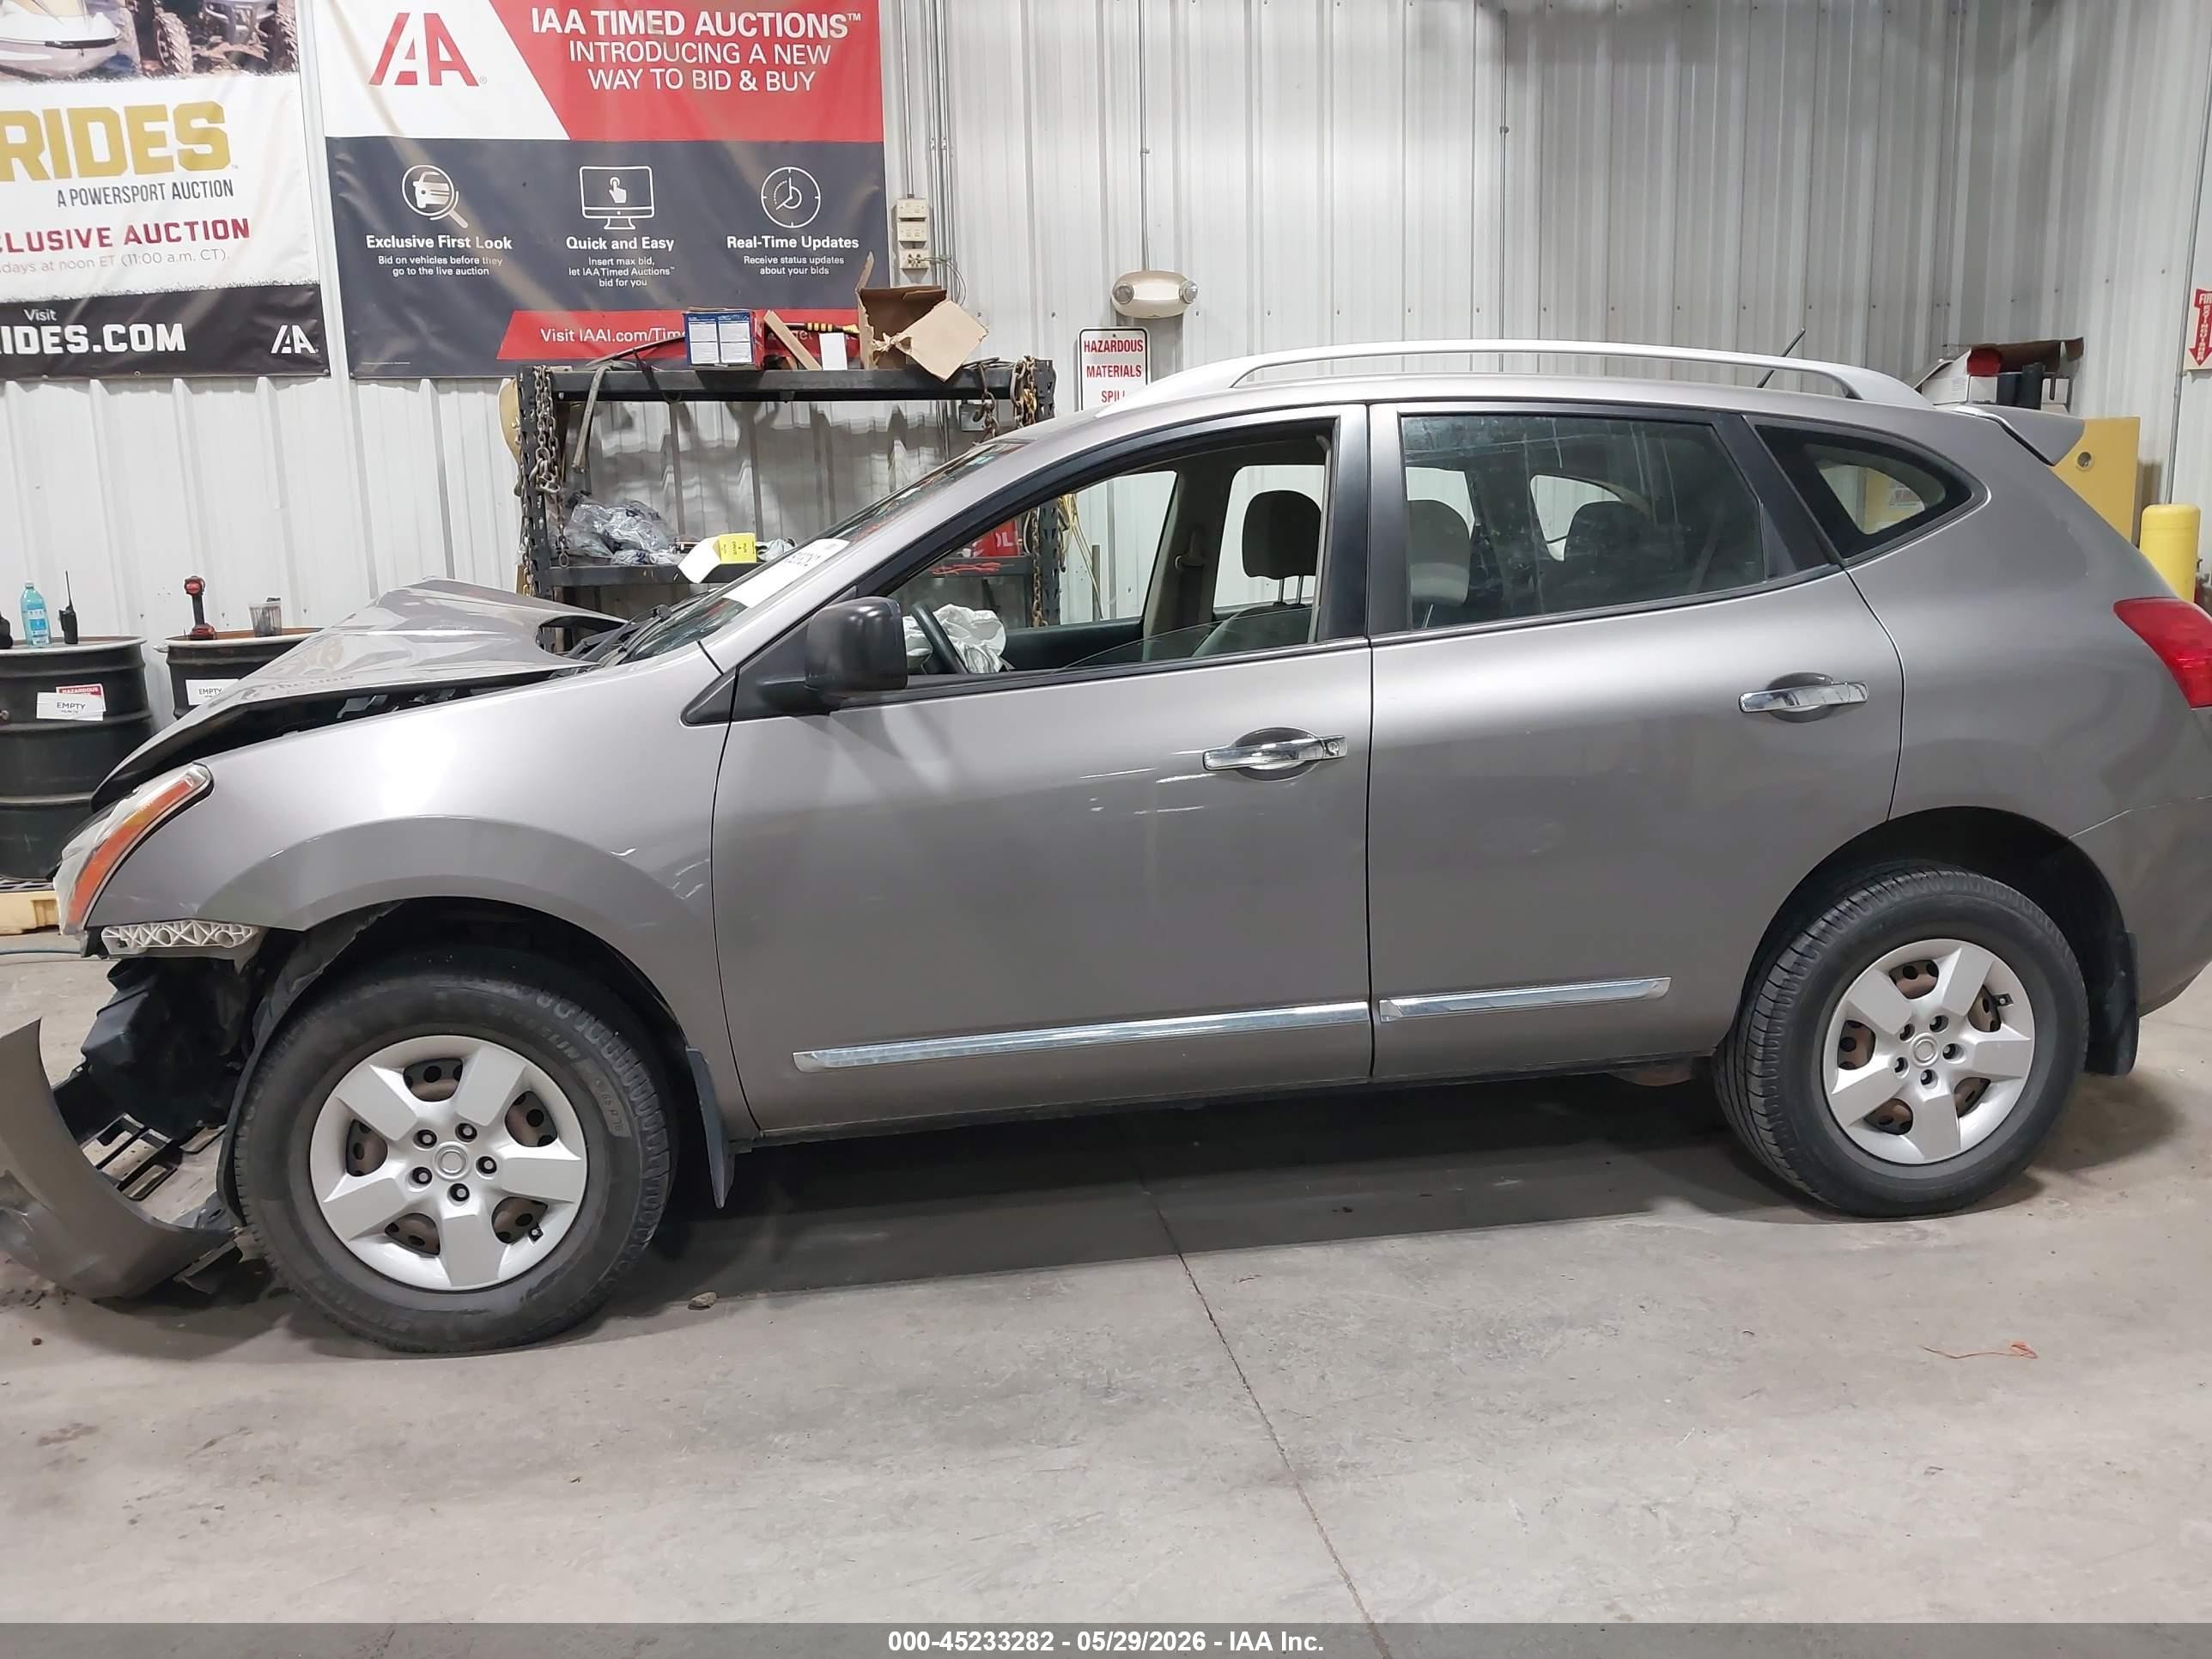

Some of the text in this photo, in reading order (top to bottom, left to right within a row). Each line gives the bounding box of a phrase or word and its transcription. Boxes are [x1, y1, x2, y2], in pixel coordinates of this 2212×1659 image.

[531, 8, 586, 35] IAA
[591, 9, 685, 37] TIMED
[569, 40, 831, 66] INTRODUCING A NEW
[587, 68, 816, 92] WAY TO BID & BUY
[58, 179, 234, 208] A POWERSPORT AUCTION
[0, 218, 250, 252] LUSIVE AUCTION
[366, 234, 513, 250] Exclusive First Look
[566, 236, 674, 252] Quick and Easy
[726, 235, 860, 251] Real-Time Updates
[41, 261, 54, 271] at
[59, 259, 95, 270] noon
[100, 255, 116, 267] ET
[121, 252, 162, 268] (11:00
[167, 254, 197, 263] a.m.
[378, 255, 393, 264] Bid
[410, 255, 448, 264] vehicles
[450, 255, 480, 265] before
[482, 256, 503, 267] they
[588, 257, 614, 266] Insert
[638, 257, 655, 266] bid,
[744, 255, 844, 265] Receive status updates
[392, 266, 489, 277] go to the live auction
[568, 267, 580, 276] let
[760, 266, 830, 276] about your bids
[599, 278, 647, 289] bid for you
[22, 309, 58, 321] Visit
[0, 324, 186, 354] IDES.COM
[539, 327, 575, 343] Visit
[1084, 339, 1144, 353] HAZARDOUS
[1086, 364, 1142, 378] MATERIALS
[57, 702, 86, 710] EMPTY
